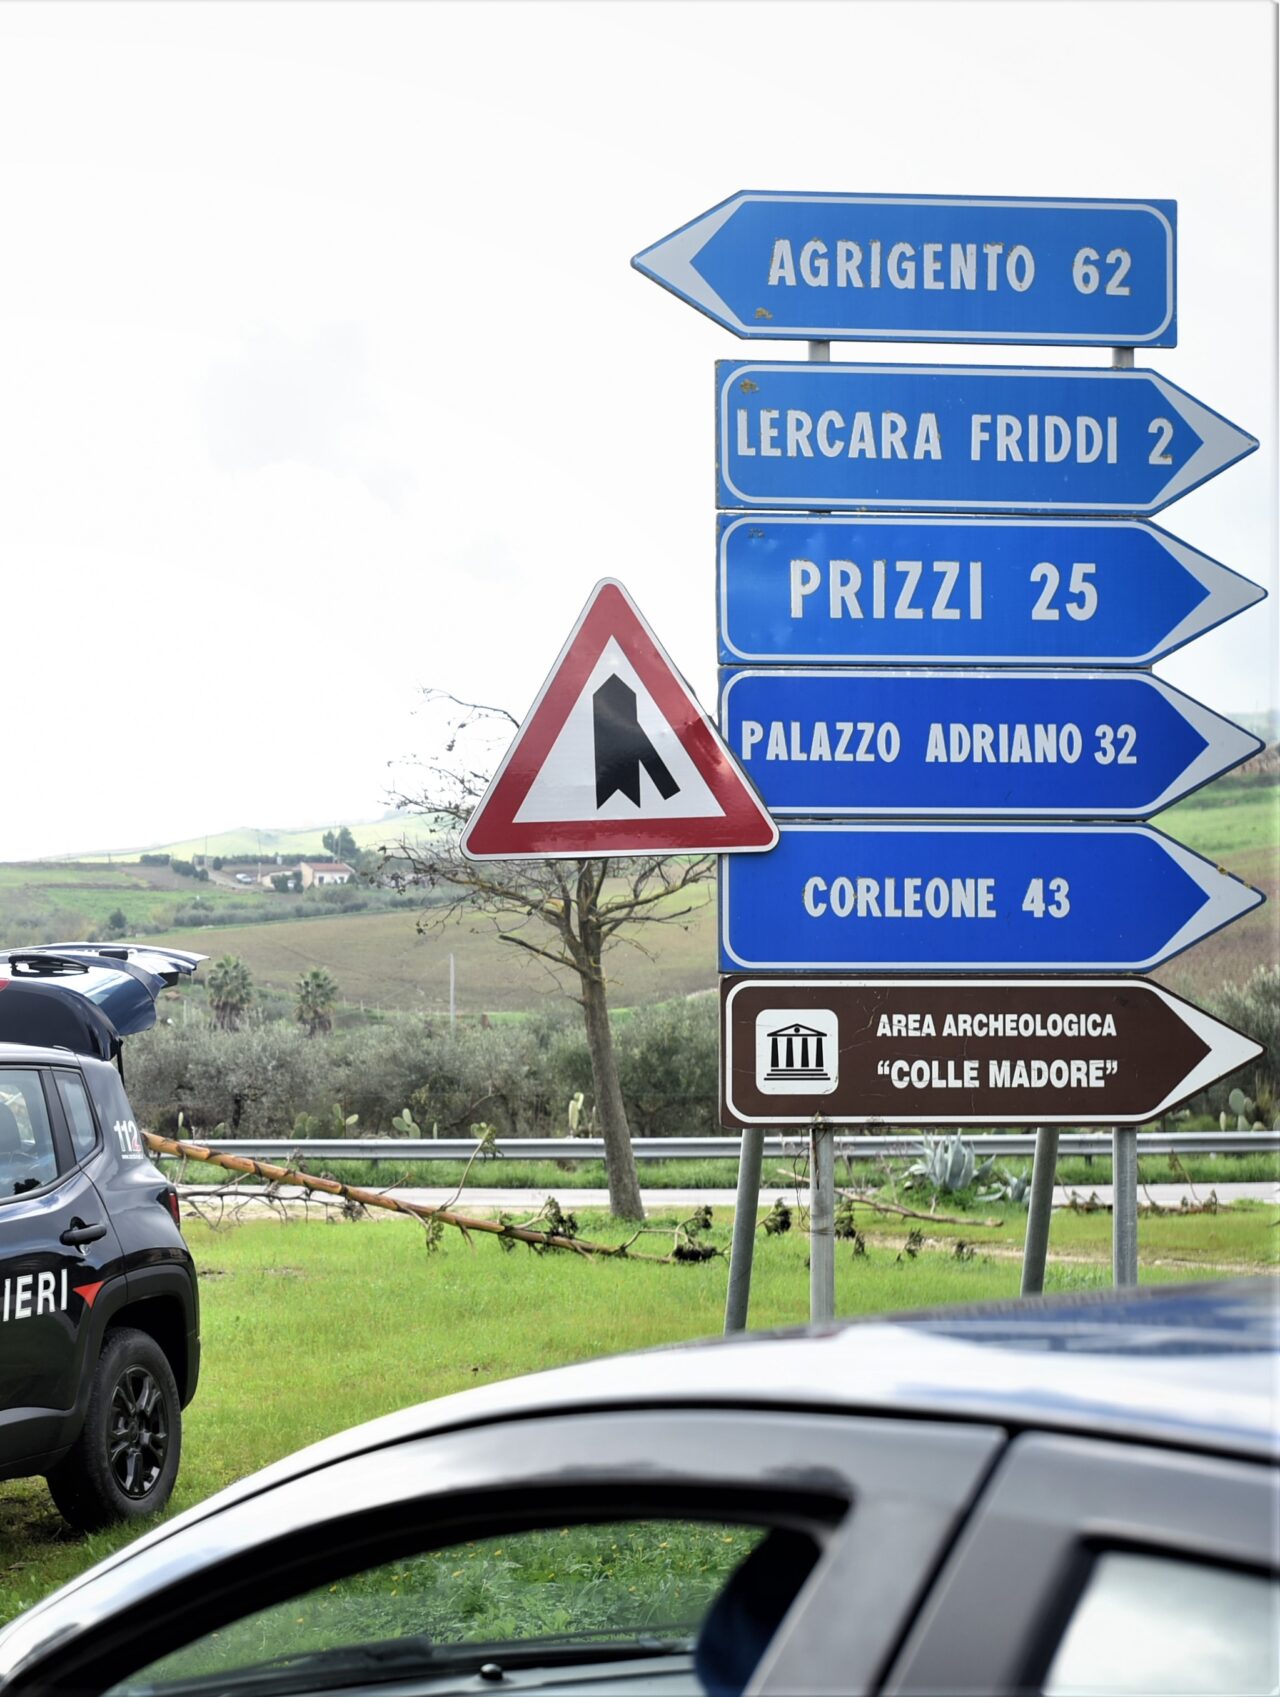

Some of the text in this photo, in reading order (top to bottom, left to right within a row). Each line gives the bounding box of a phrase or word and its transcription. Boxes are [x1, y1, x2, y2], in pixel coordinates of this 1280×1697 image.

[768, 239, 1131, 295] AGRIGENTO 62
[737, 409, 1173, 464] LERCARA FRIDDI 2
[791, 560, 1097, 620] PRIZZI 25
[742, 721, 1136, 764] PALAZZO ADRIANO 32
[804, 877, 1070, 918] CORLEONE 43
[877, 1014, 1116, 1037] AREA ARCHEOLOGICA
[113, 1120, 141, 1152] 112
